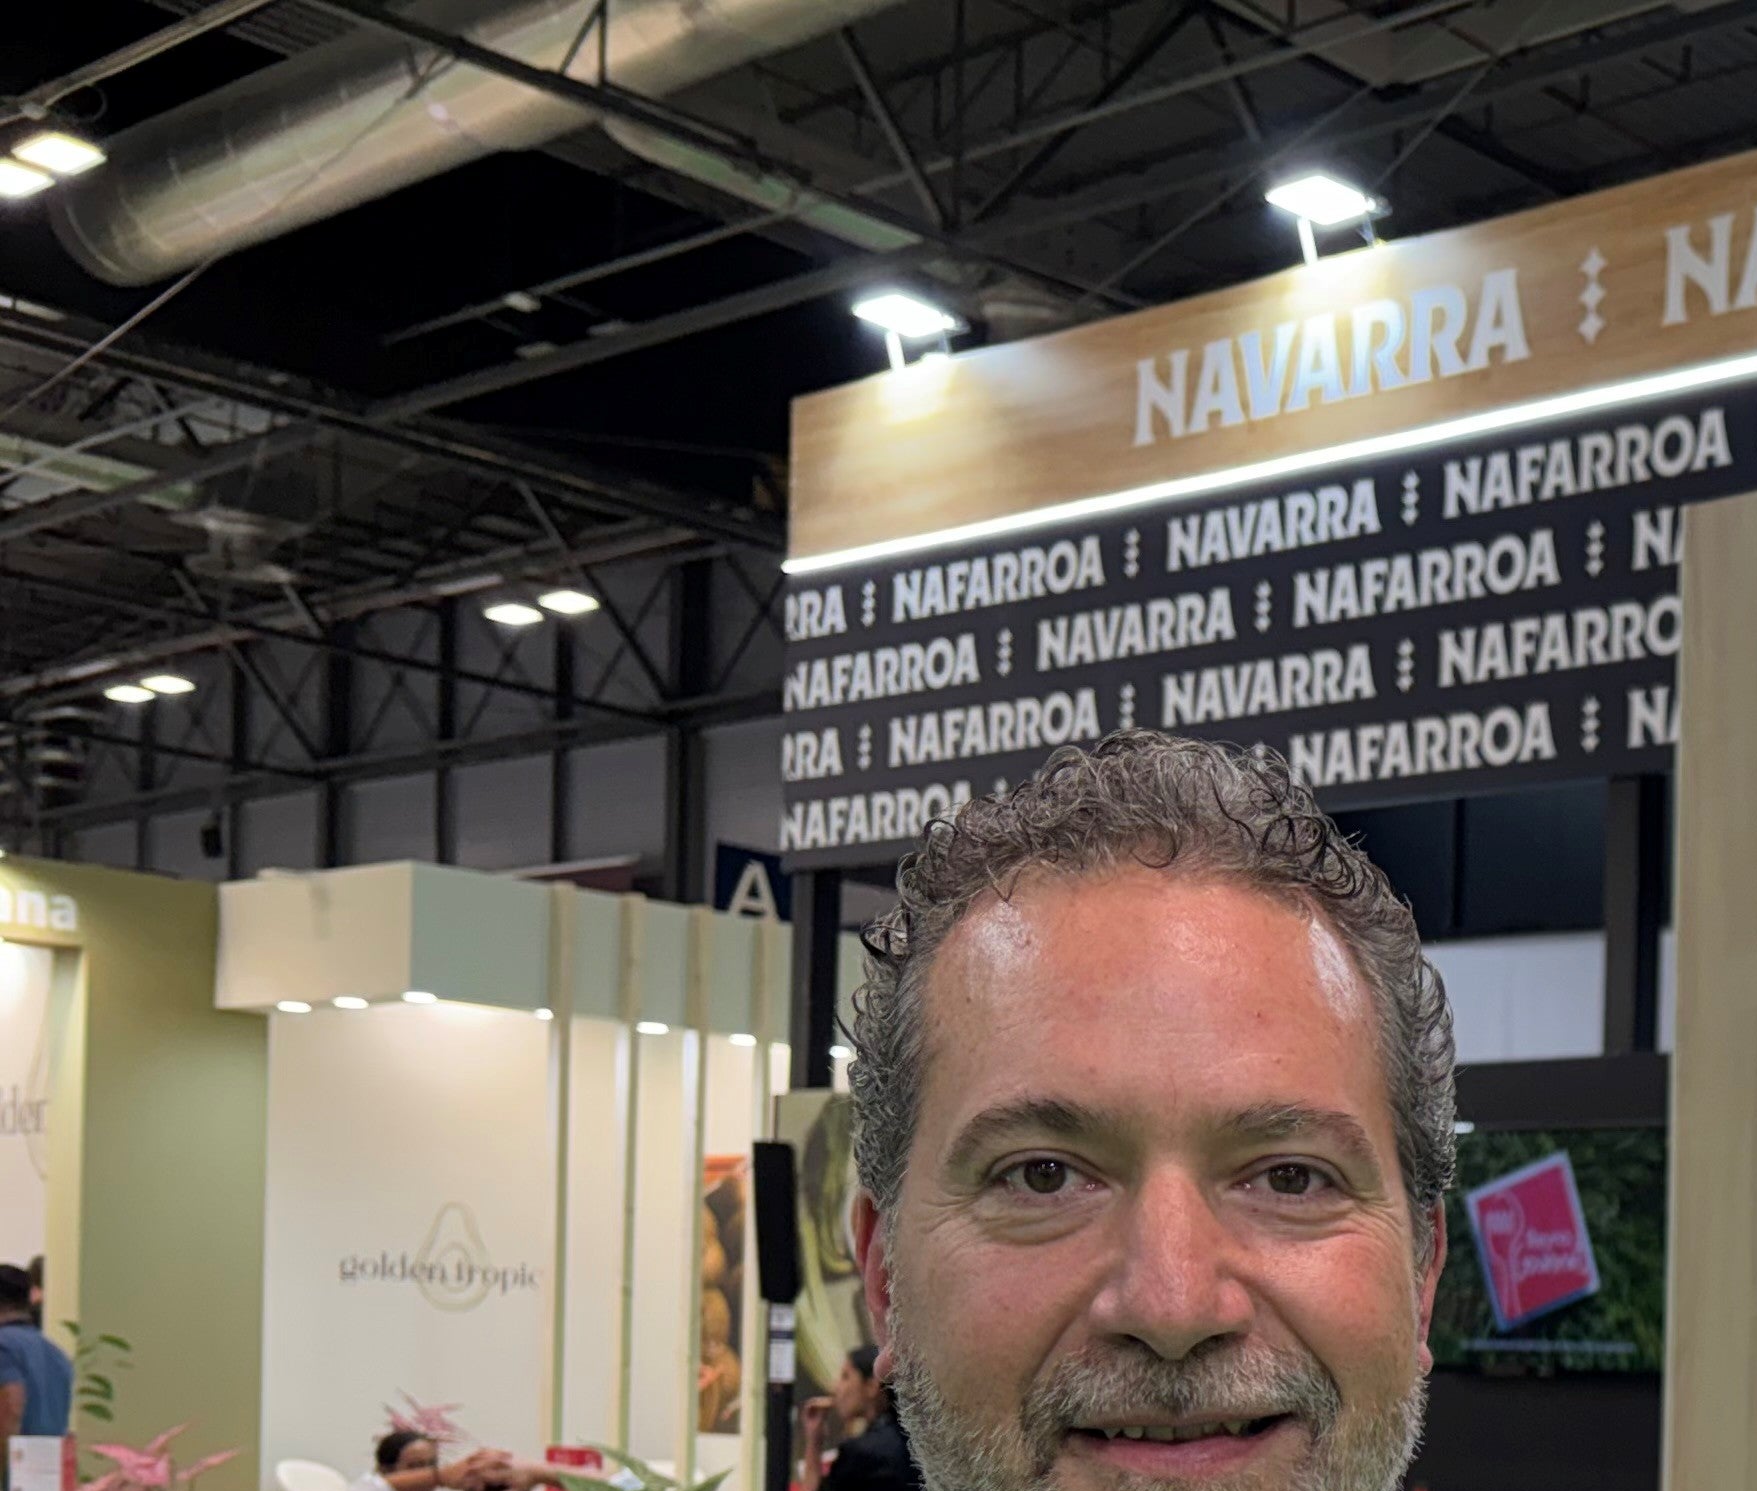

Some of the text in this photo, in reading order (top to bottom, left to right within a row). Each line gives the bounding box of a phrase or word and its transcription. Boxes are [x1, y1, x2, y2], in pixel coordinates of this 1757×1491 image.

[1132, 268, 1532, 446] NAVARRA
[892, 535, 1106, 623] NAFARROA
[1166, 478, 1382, 573] NAVARRA
[1442, 408, 1733, 520] NAFARROA
[783, 633, 980, 712] NAFARROA
[1037, 586, 1236, 672] NAVARRA
[1293, 528, 1561, 628] NAFARROA
[889, 687, 1100, 768] NAFARROA
[1162, 643, 1376, 729] NAVARRA
[1287, 703, 1558, 787] NAFARROA
[339, 1250, 447, 1286] golden
